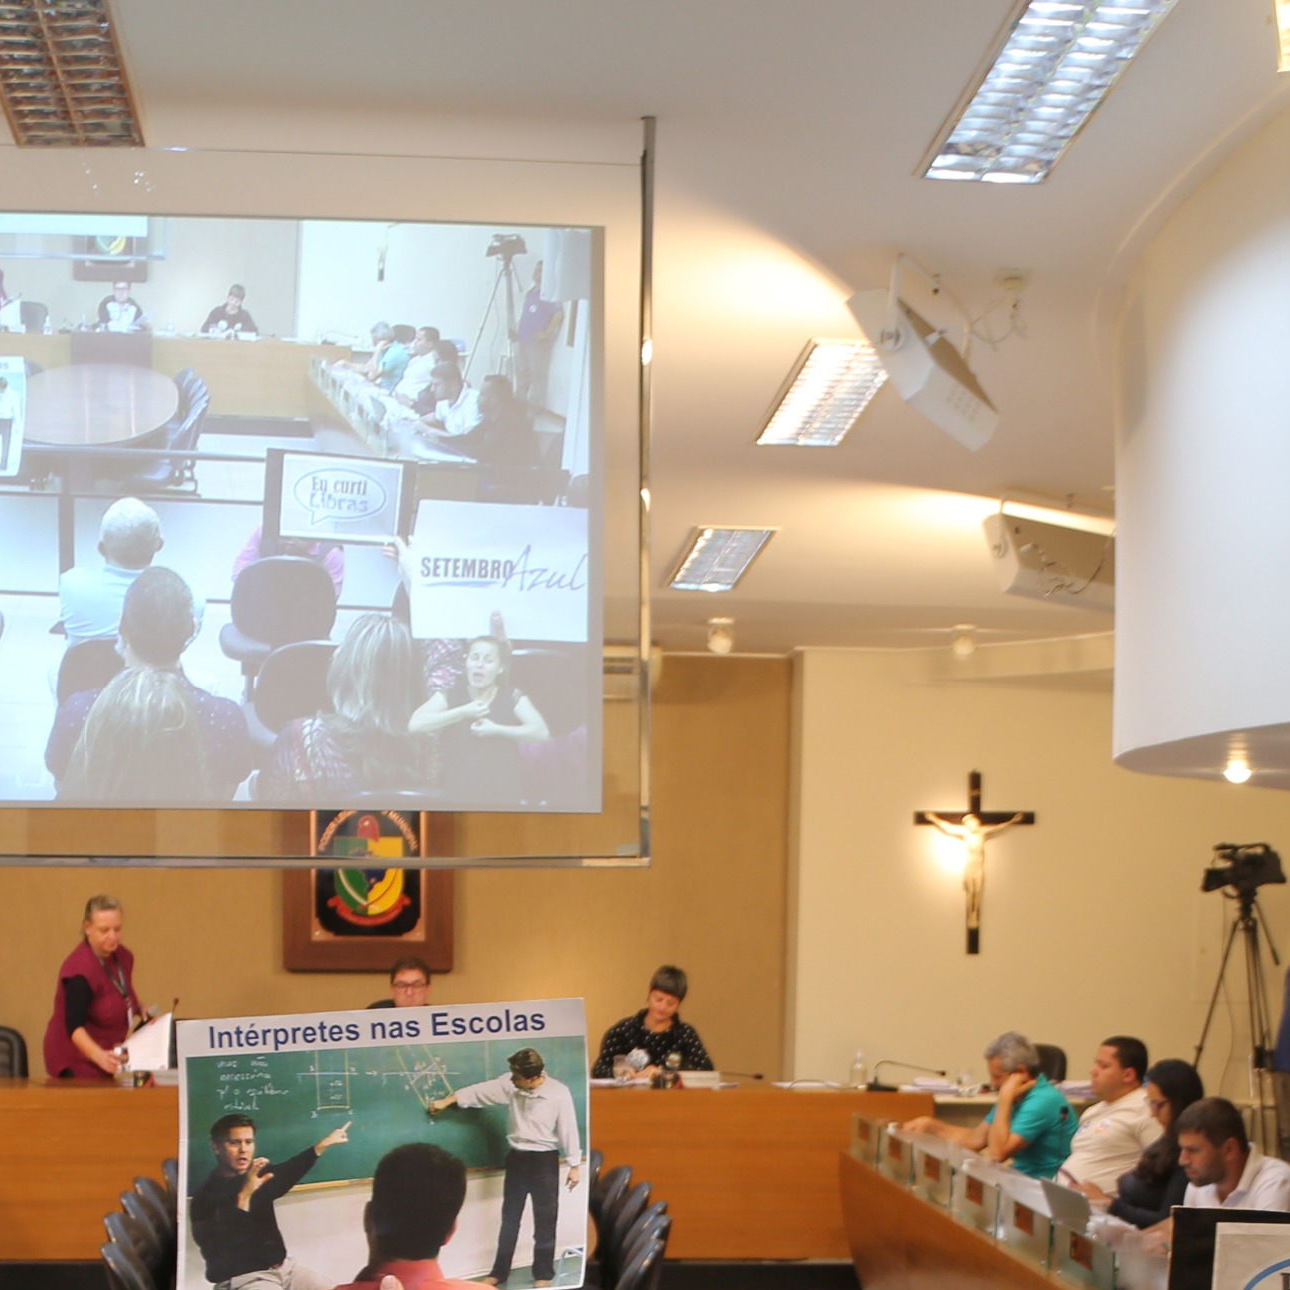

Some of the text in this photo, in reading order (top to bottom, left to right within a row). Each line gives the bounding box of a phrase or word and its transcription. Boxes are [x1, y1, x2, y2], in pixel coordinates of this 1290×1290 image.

[311, 475, 367, 496] Eu curti
[309, 492, 369, 513] Libras
[420, 543, 588, 592] SETEMBRO Azul
[209, 1008, 546, 1051] Intérpretes nas Escolas
